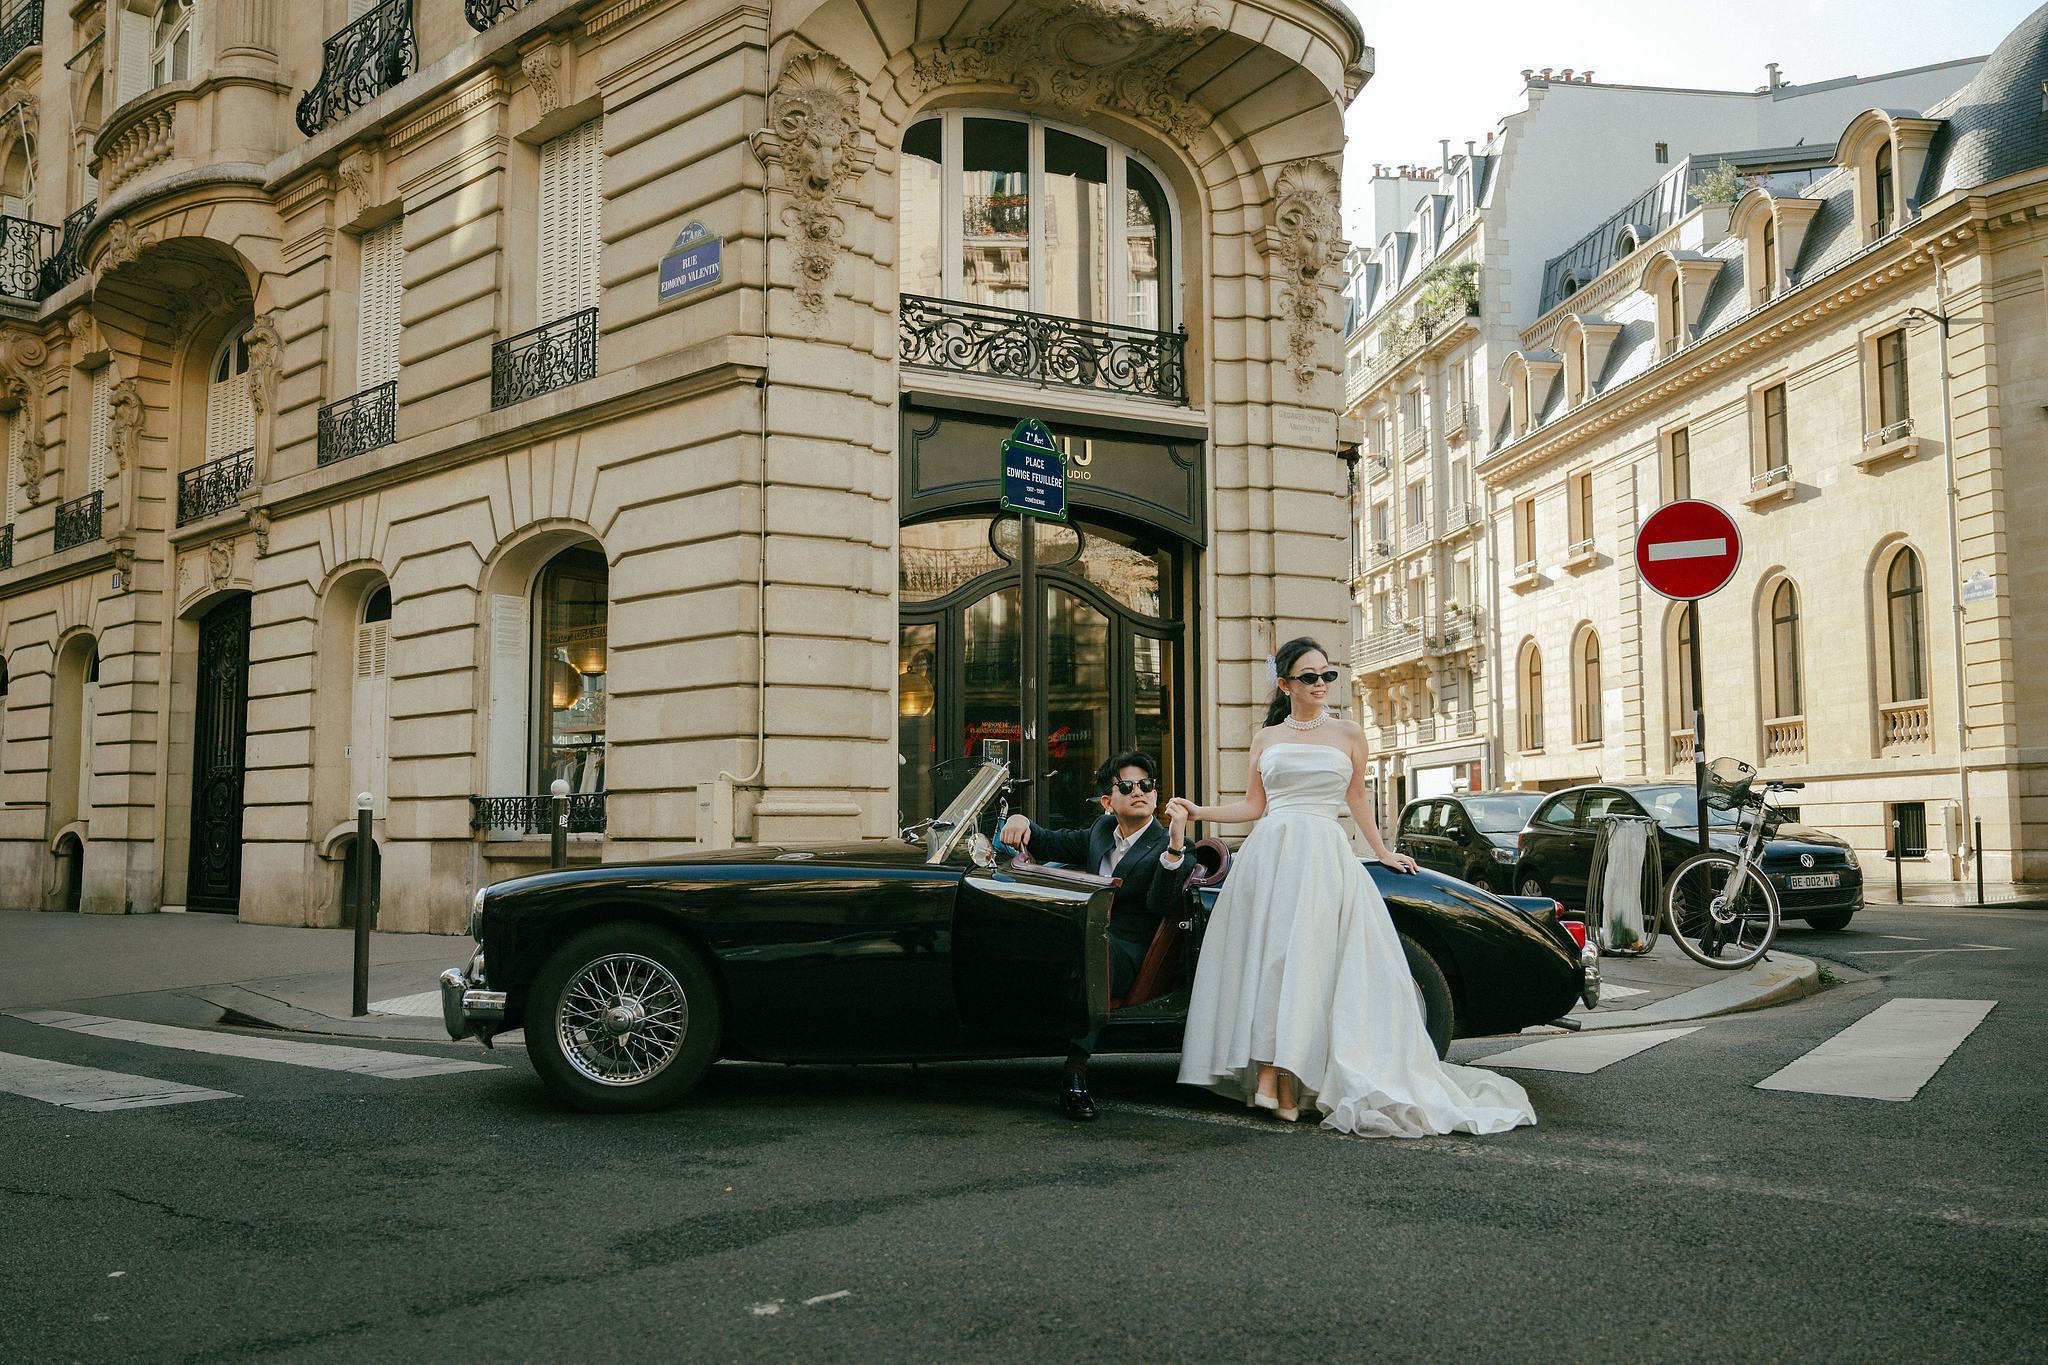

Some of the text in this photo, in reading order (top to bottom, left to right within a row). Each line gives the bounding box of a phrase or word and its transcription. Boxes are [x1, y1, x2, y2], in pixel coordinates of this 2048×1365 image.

[682, 255, 697, 269] RUE
[661, 262, 720, 292] EDMOND VALENTIN
[1025, 456, 1045, 469] PLACE
[1006, 466, 1031, 481] EDWIGE
[1067, 470, 1091, 480] UDIO
